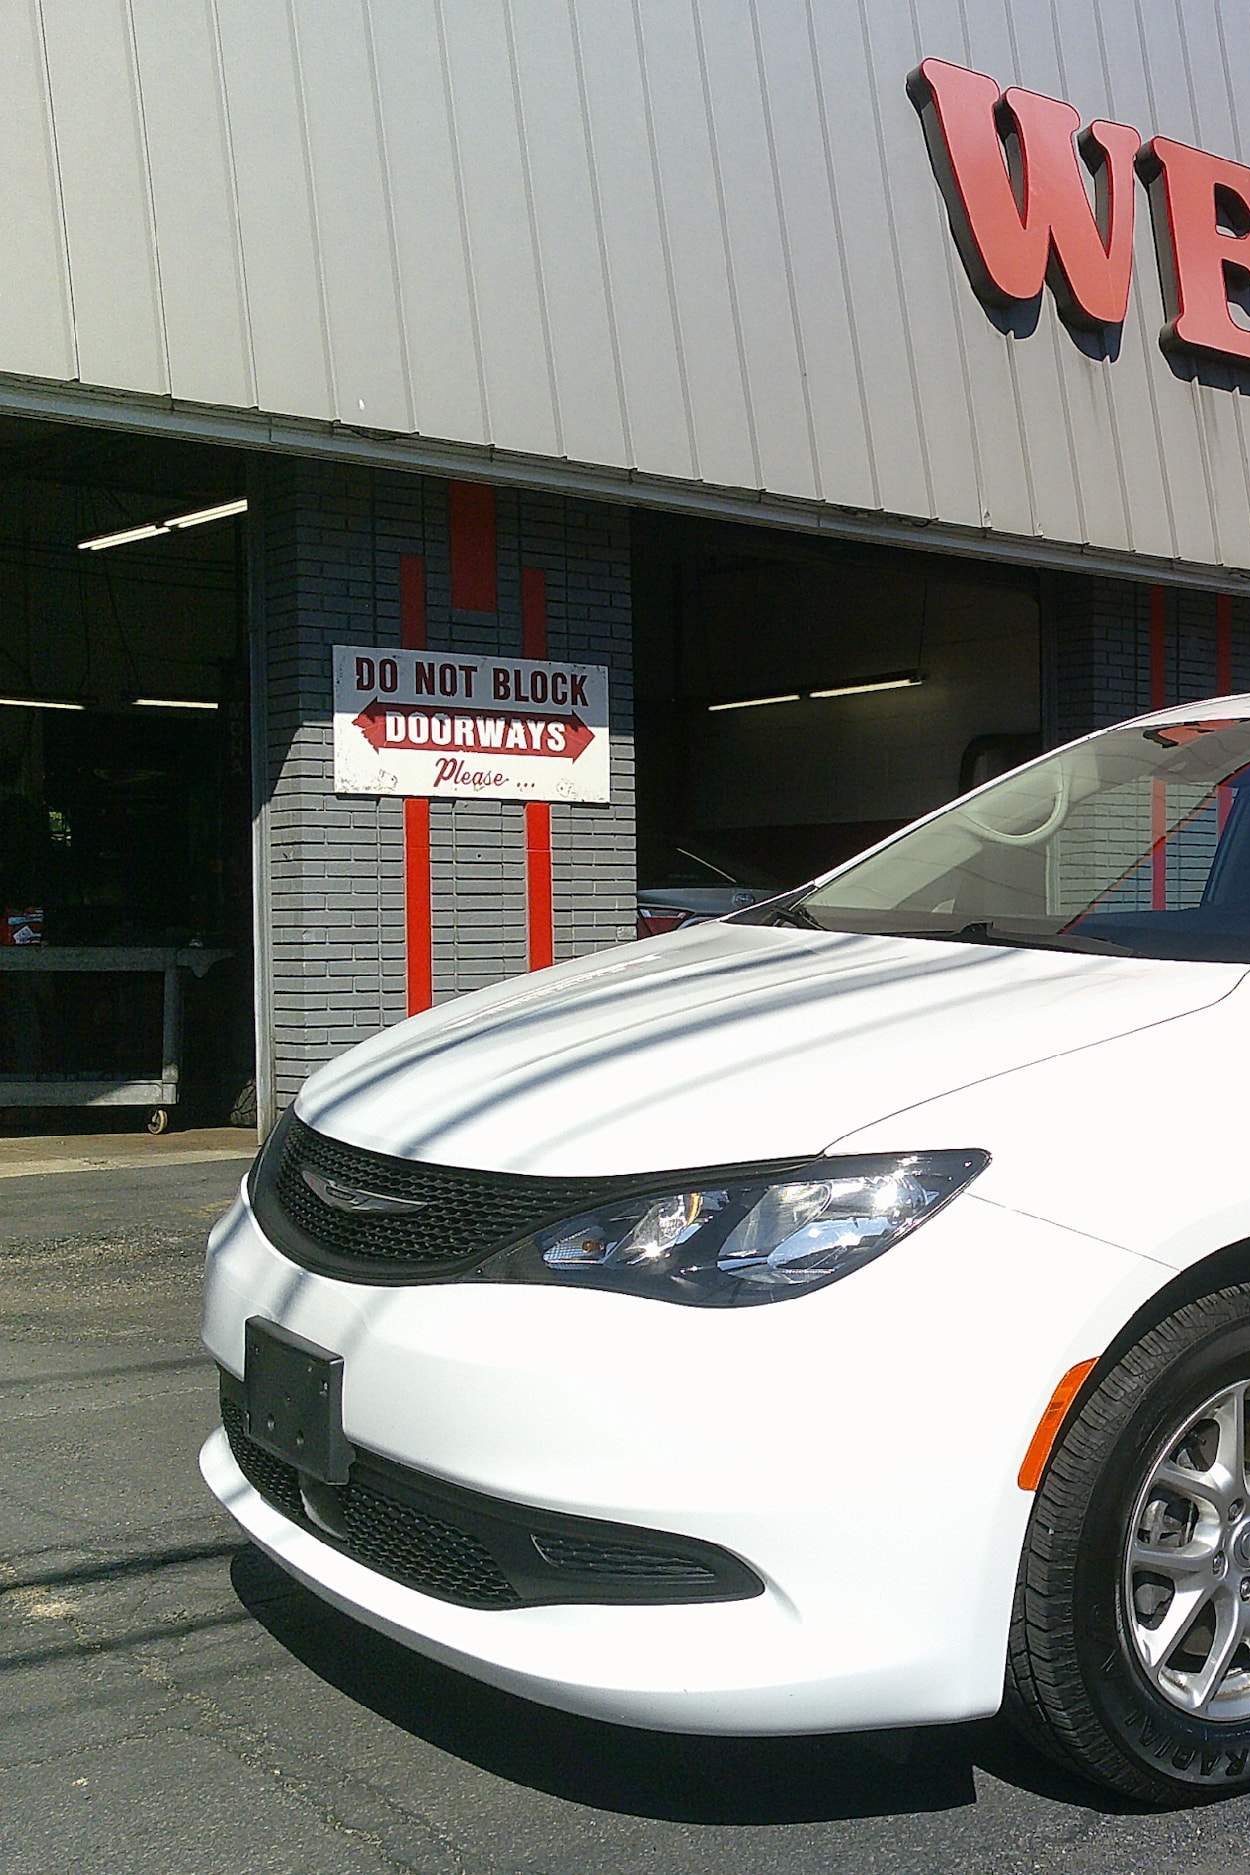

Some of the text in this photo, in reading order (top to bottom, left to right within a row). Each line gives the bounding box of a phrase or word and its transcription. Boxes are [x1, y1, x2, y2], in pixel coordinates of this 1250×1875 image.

[355, 656, 589, 707] DO NOT BLOCK
[385, 711, 566, 752] DOORWAYS
[433, 757, 510, 788] Please
